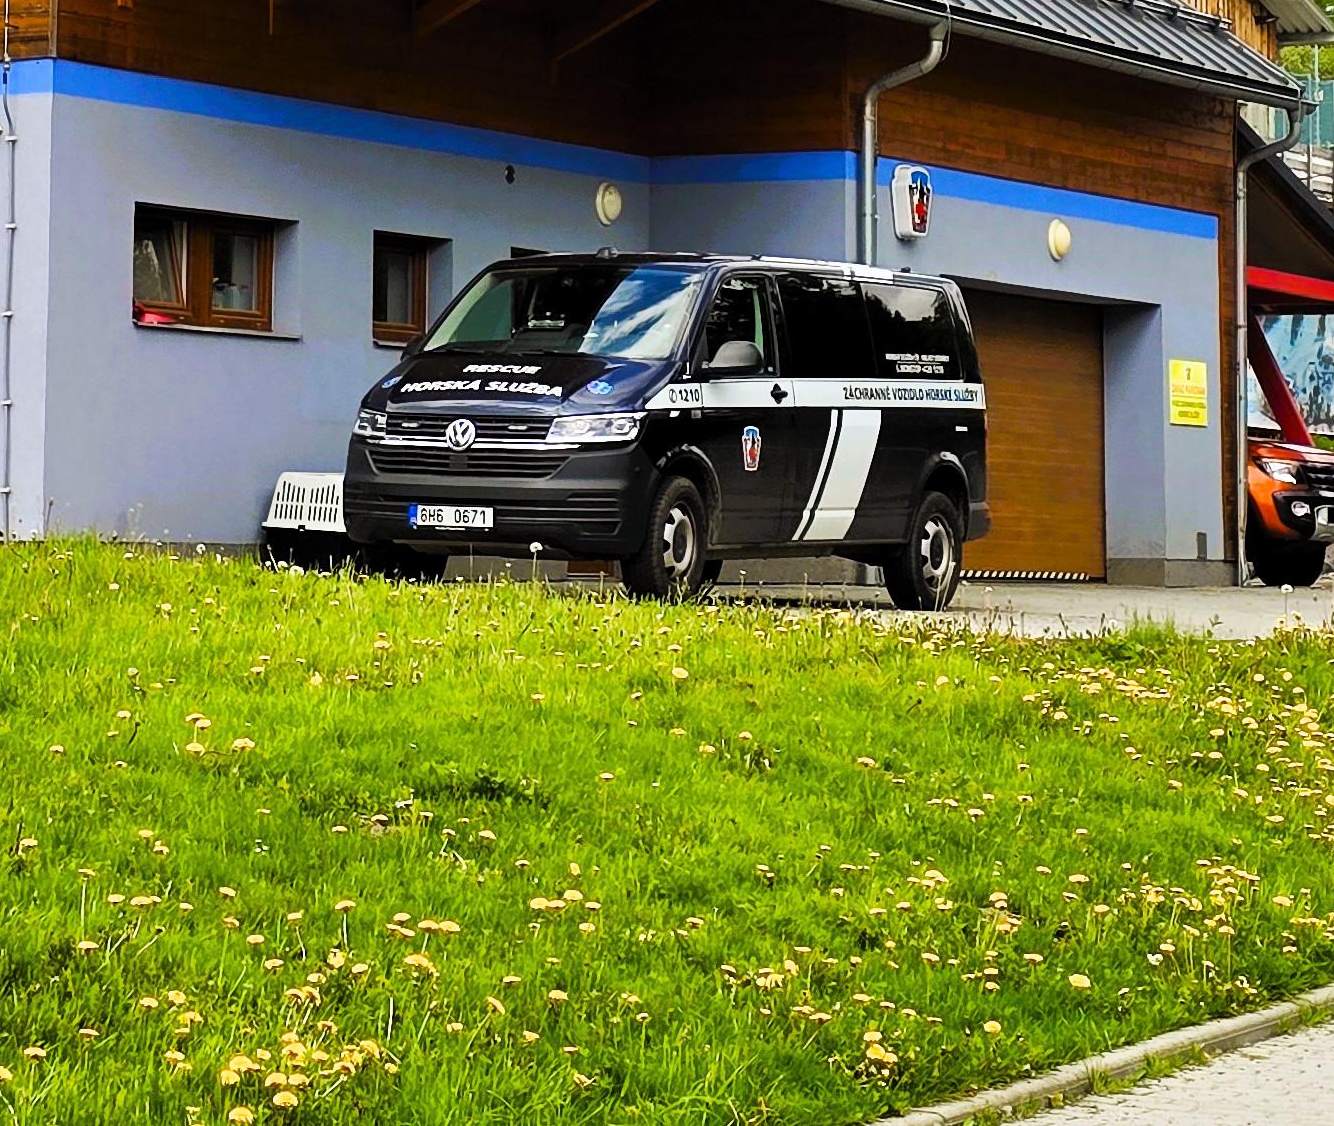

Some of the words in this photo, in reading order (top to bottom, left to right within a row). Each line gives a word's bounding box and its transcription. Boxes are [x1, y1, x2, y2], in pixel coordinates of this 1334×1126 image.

[463, 365, 542, 375] RESCUE
[678, 388, 700, 402] 1210
[892, 388, 924, 401] VOZIDLO
[454, 508, 486, 525] 0671
